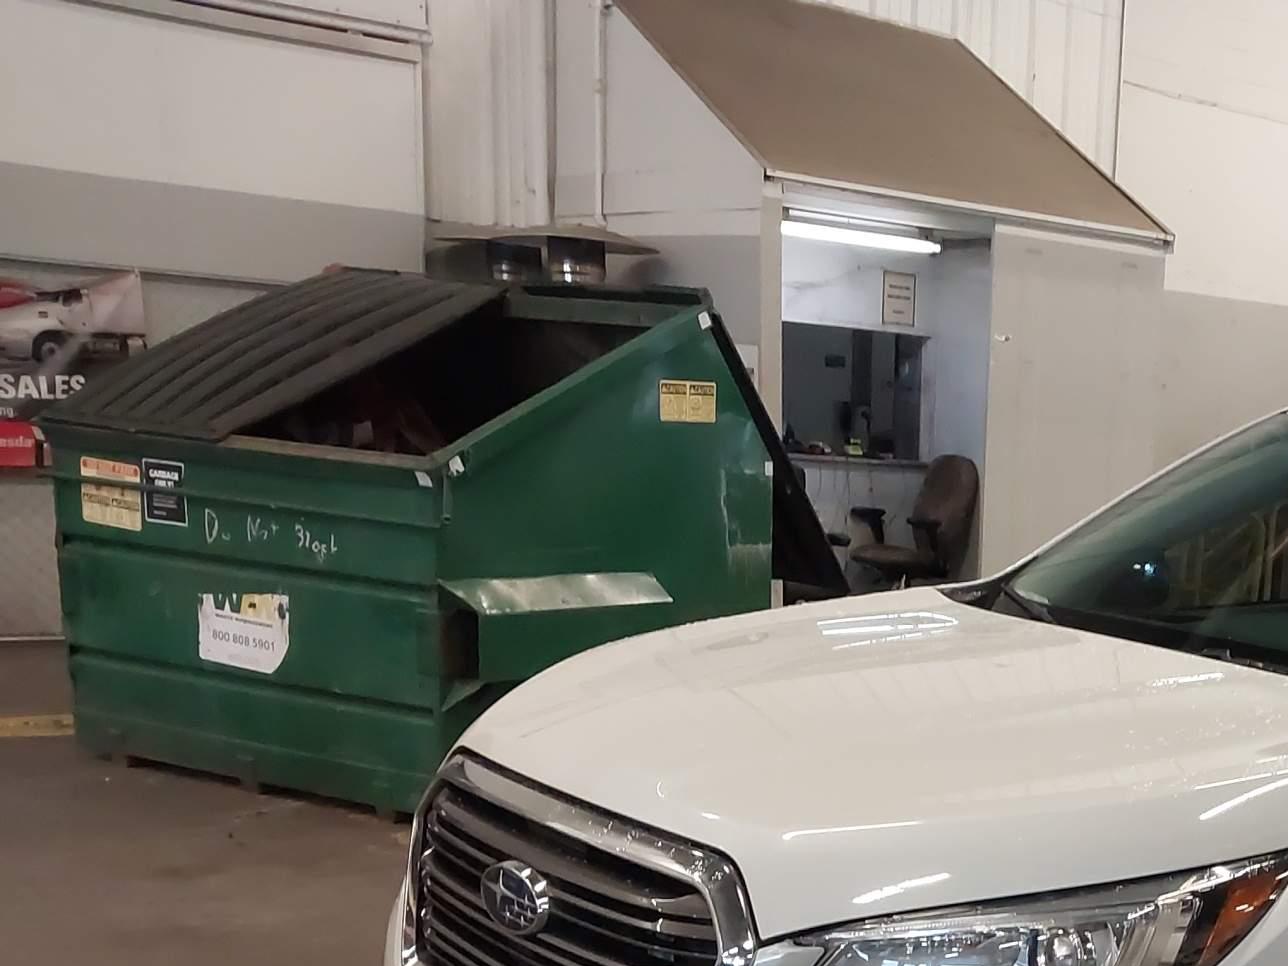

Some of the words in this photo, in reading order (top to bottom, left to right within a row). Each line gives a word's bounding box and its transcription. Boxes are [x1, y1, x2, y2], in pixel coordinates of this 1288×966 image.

[0, 373, 86, 399] SALES
[212, 629, 230, 642] 800
[232, 633, 250, 647] 808
[252, 638, 275, 652] 5901
